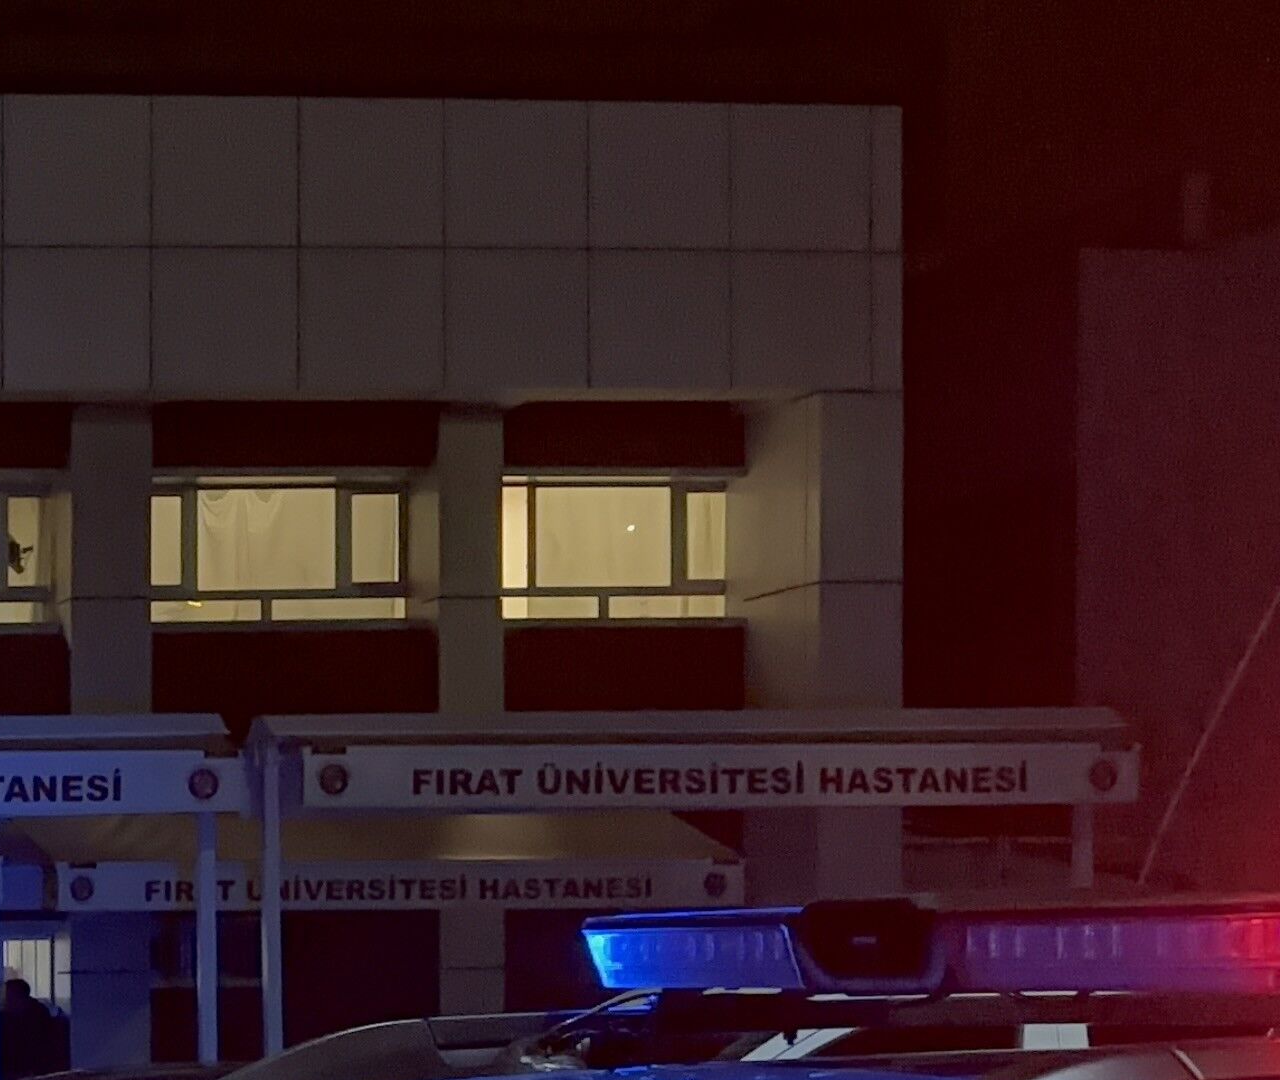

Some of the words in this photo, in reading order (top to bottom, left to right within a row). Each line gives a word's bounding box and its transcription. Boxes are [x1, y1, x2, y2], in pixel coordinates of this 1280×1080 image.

[412, 768, 523, 797] FIRAT
[537, 761, 803, 796] ÜNİVERSİTESİ
[819, 760, 1029, 794] HASTANESİ
[145, 879, 237, 902] FIRT
[480, 876, 654, 900] HASTANESİ
